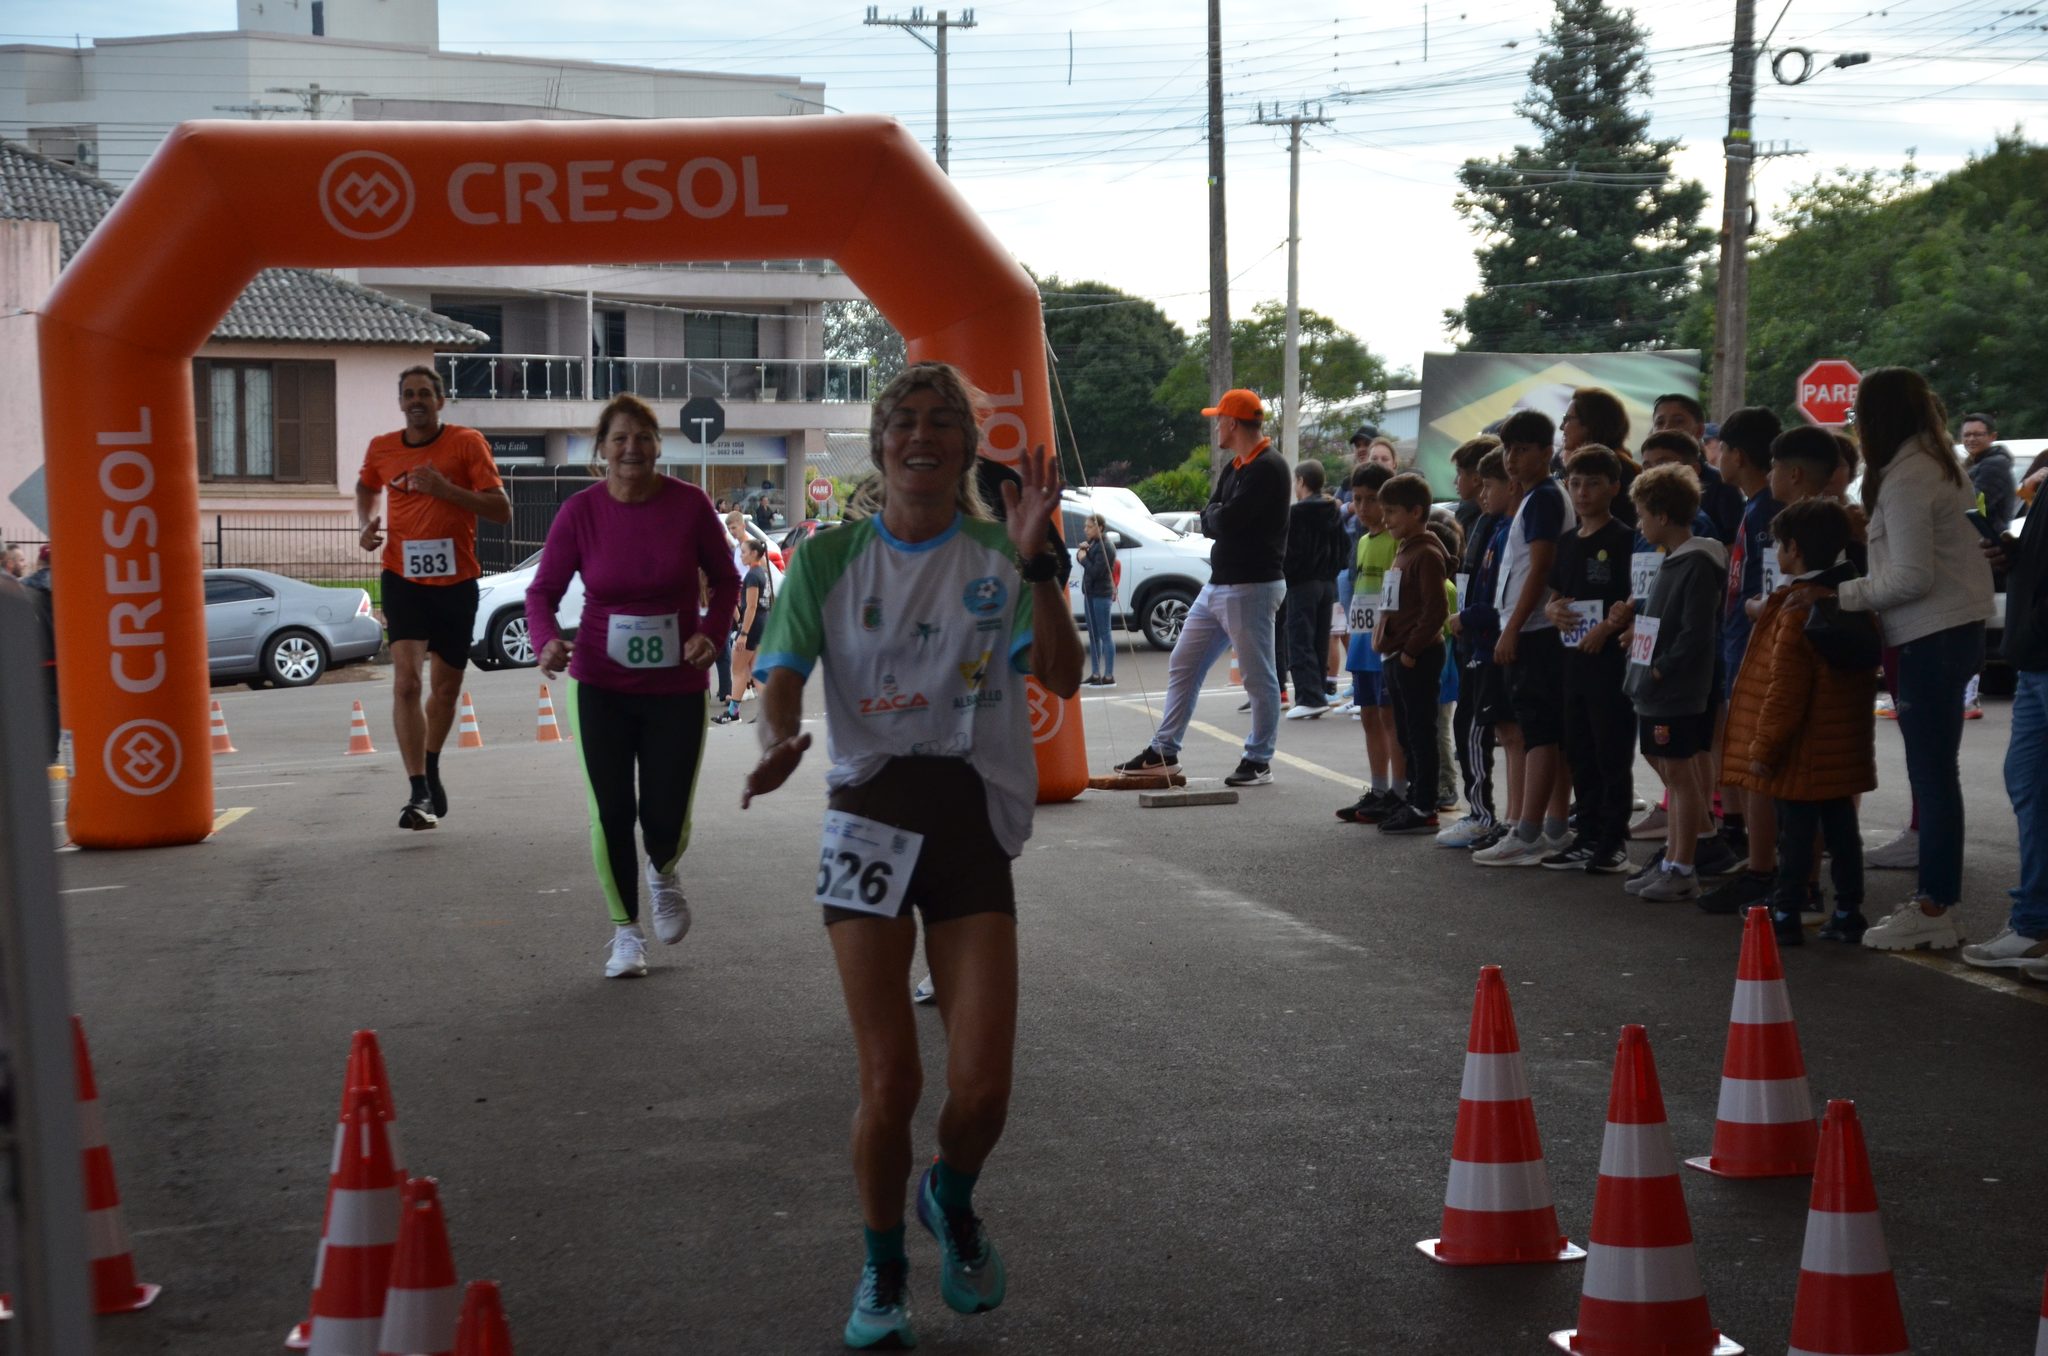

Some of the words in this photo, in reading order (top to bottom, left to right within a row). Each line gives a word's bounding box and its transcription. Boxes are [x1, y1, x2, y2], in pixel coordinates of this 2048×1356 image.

[446, 154, 790, 225] CRESOL
[1803, 383, 1859, 403] PARE
[812, 485, 829, 495] PARE
[96, 405, 167, 694] CRESOL
[410, 553, 448, 575] 583
[1350, 608, 1375, 630] 968
[627, 635, 664, 664] 88
[859, 691, 929, 714] ZACA
[815, 847, 894, 905] 526
